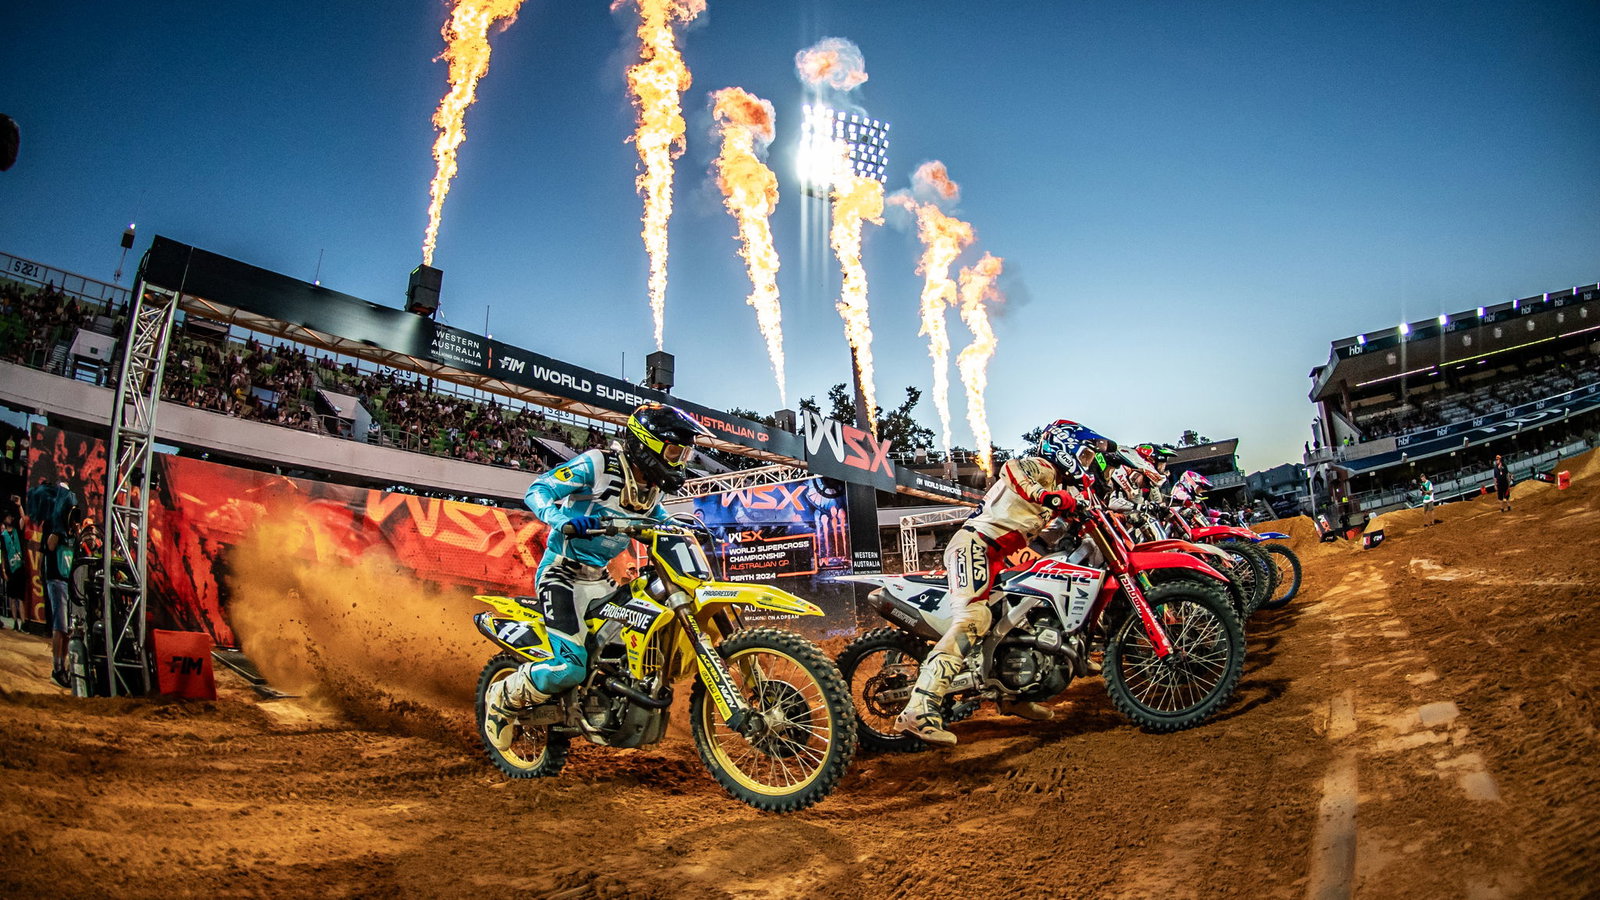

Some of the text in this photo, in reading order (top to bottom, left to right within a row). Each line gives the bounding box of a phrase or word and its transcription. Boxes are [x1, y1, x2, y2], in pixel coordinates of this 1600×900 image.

[13, 260, 39, 278] S221
[436, 330, 480, 349] WESTERN
[430, 349, 453, 359] WALKING
[464, 358, 482, 367] DREAM
[431, 339, 482, 359] AUSTRALIA
[499, 356, 662, 406] FIM WORLD SUPER
[688, 411, 769, 443] AUSTRALIAN GP
[1472, 417, 1483, 427] hbf
[1397, 435, 1410, 446] hbf
[1436, 426, 1448, 437] hbf
[803, 408, 894, 478] WSX
[722, 484, 808, 511] WSX
[366, 489, 545, 569] WSX
[728, 530, 763, 543] WSX
[729, 540, 810, 555] WORLD SUPERCROSS
[854, 551, 878, 559] WESTERN
[671, 542, 709, 573] 11
[729, 552, 786, 563] CHAMPIONSHIP
[729, 561, 777, 571] AUSTRALIAN
[853, 560, 881, 568] AUSTRALIA
[957, 548, 967, 587] MCR
[730, 572, 776, 582] PERTH 2024
[599, 603, 652, 630] PROGRESSIVE
[498, 621, 530, 645] 11
[165, 655, 204, 676] FIM
